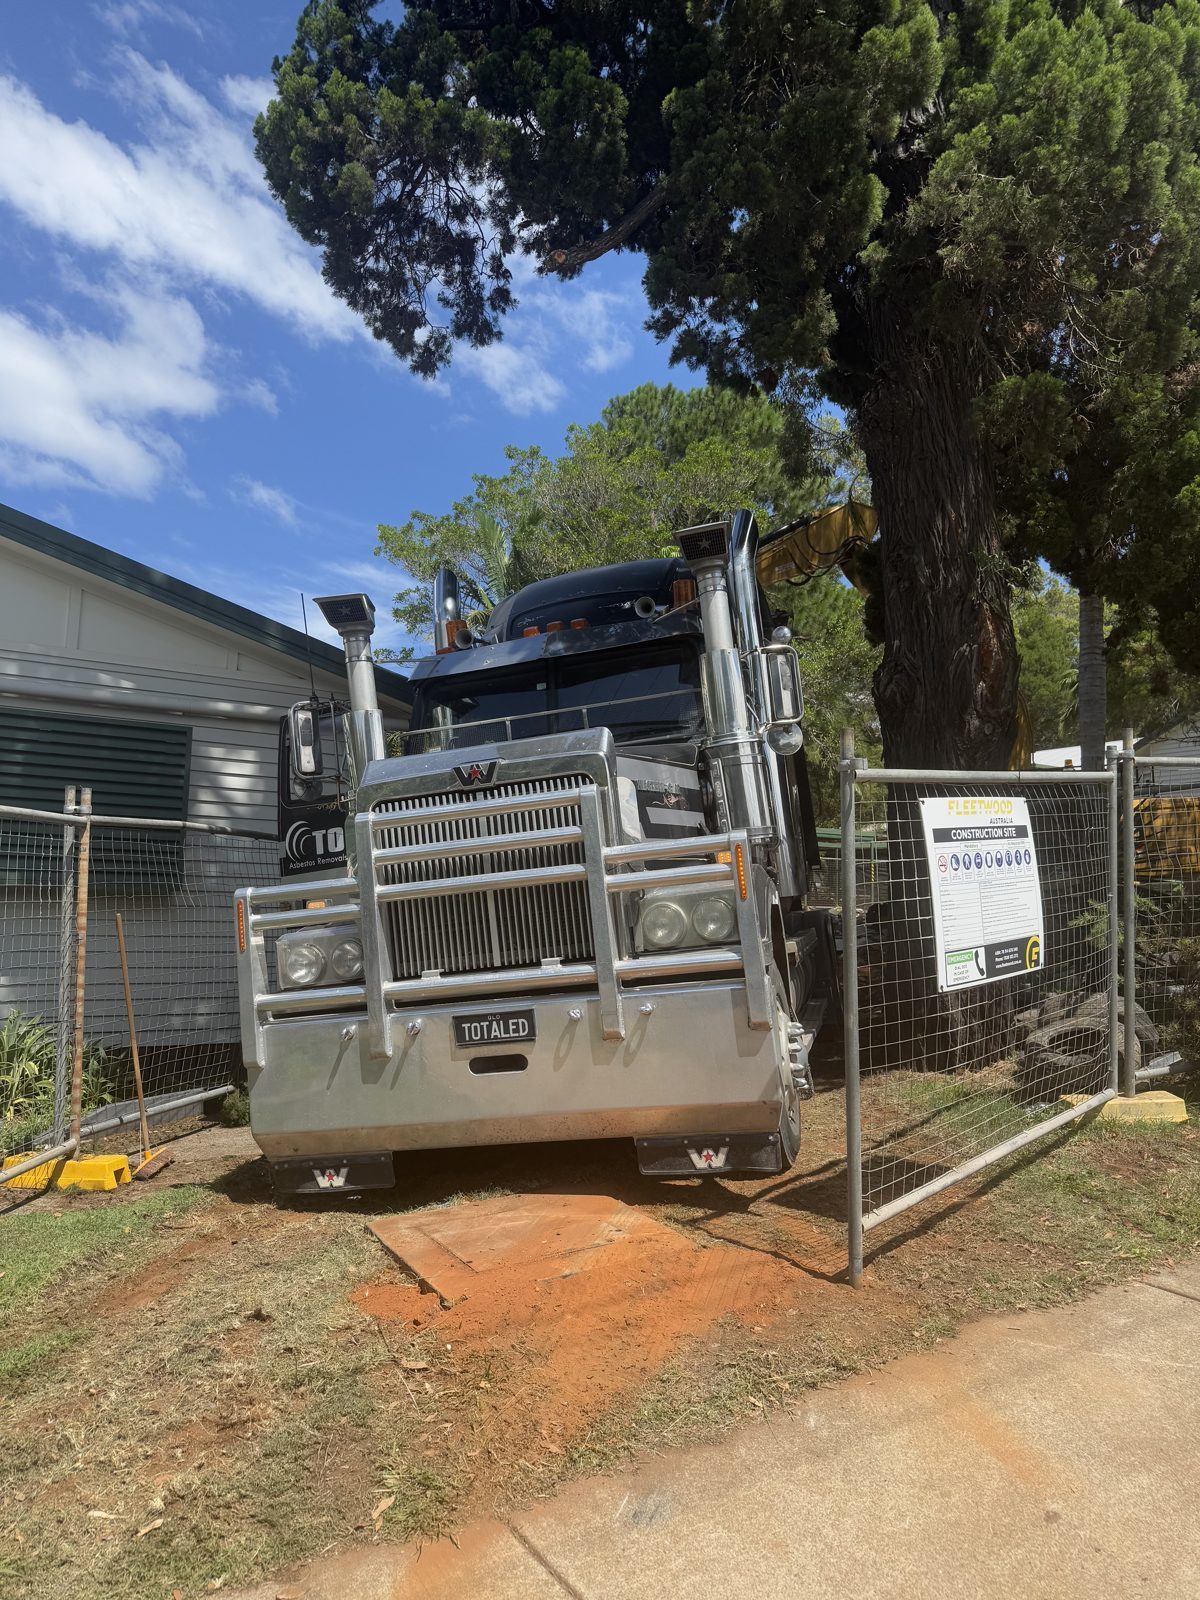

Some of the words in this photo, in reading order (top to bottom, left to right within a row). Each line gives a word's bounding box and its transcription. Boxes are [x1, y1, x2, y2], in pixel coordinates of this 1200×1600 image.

[948, 799, 1013, 815] FLEETWOOD
[951, 828, 1003, 840] CONSTRUCTION
[1003, 827, 1017, 837] SITE
[289, 860, 316, 870] Asbestos
[317, 854, 349, 865] Removals
[947, 953, 973, 963] EMERGENCY
[462, 1018, 529, 1041] TOTALED
